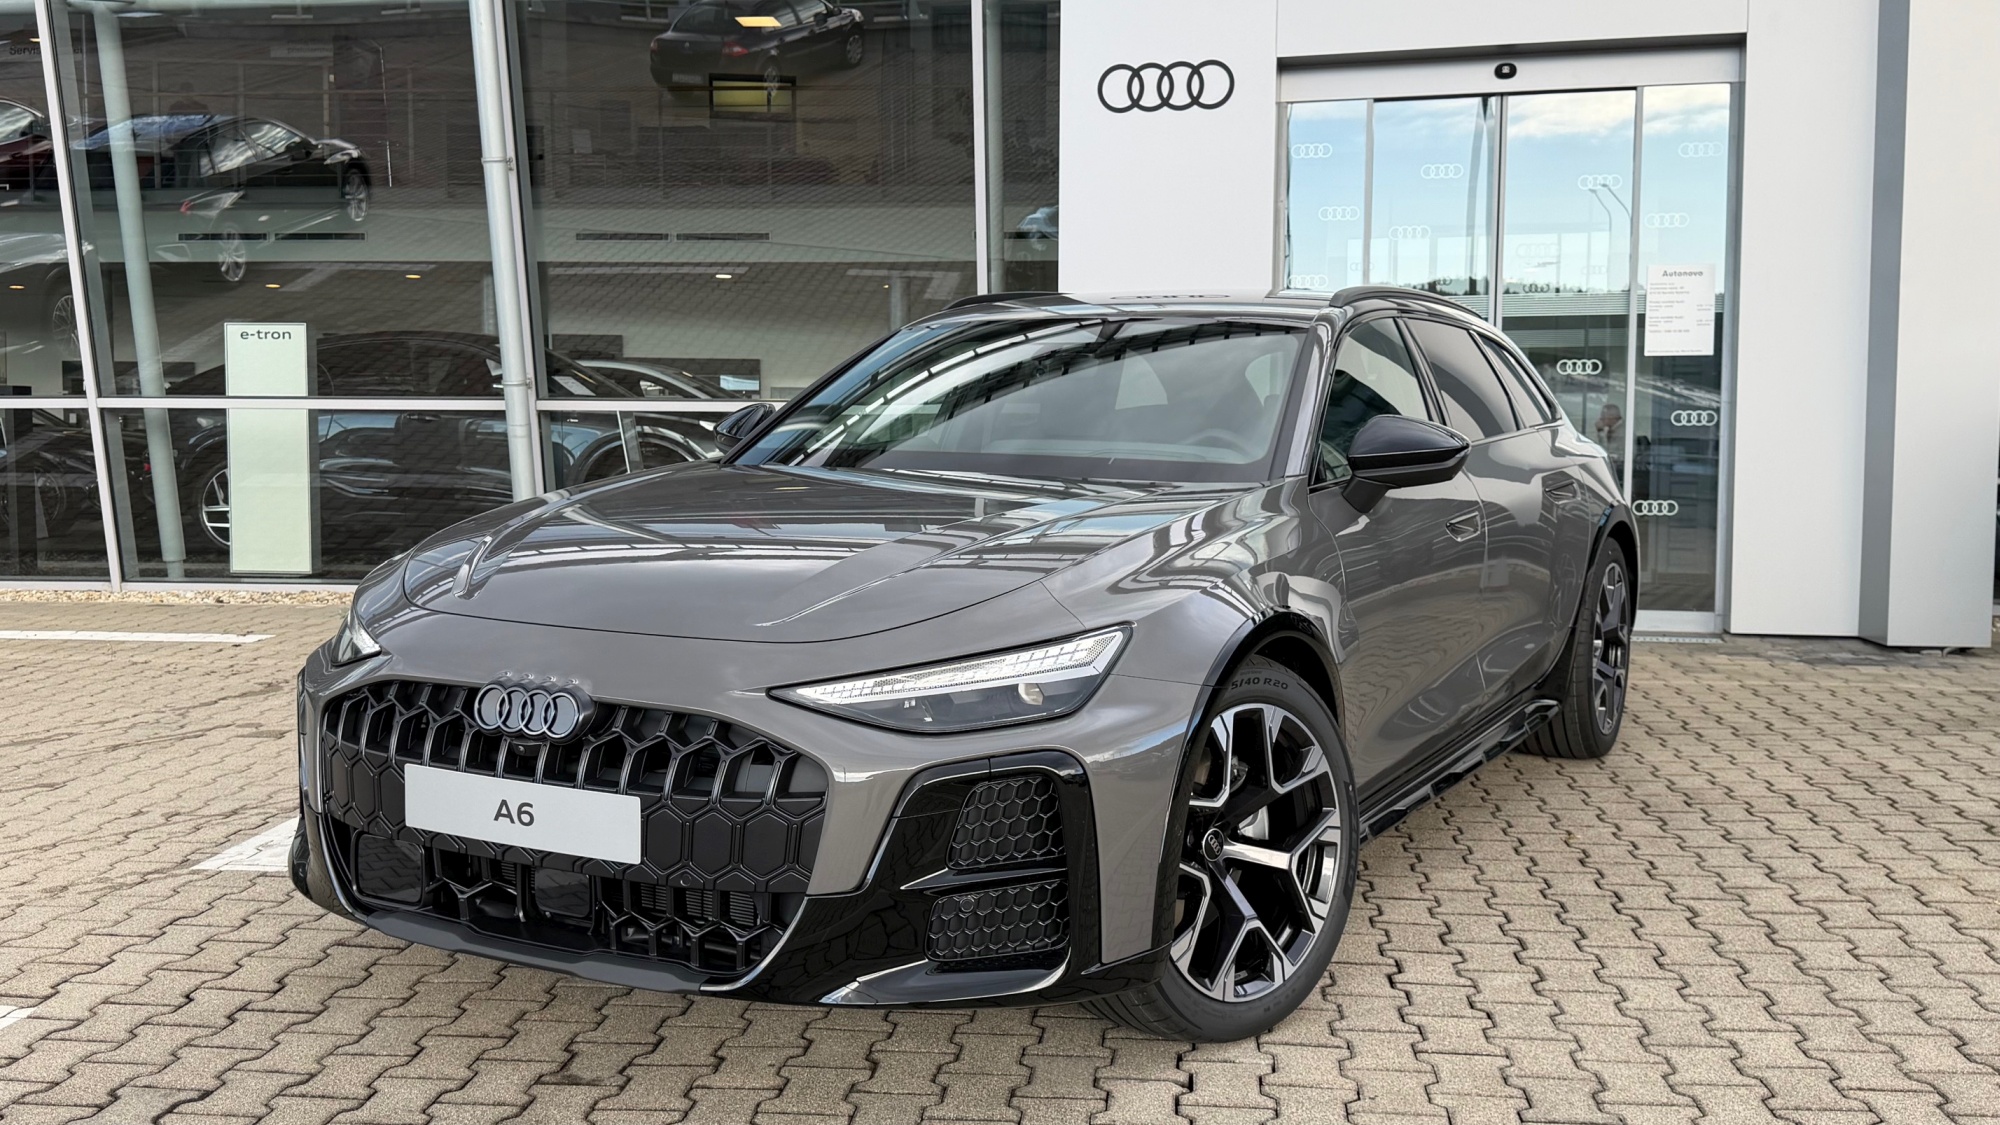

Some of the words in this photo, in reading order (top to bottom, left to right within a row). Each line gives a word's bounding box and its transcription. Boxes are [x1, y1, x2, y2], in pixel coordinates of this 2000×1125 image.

[240, 329, 292, 340] e-tron
[1263, 677, 1289, 690] R20
[493, 798, 535, 827] A6
